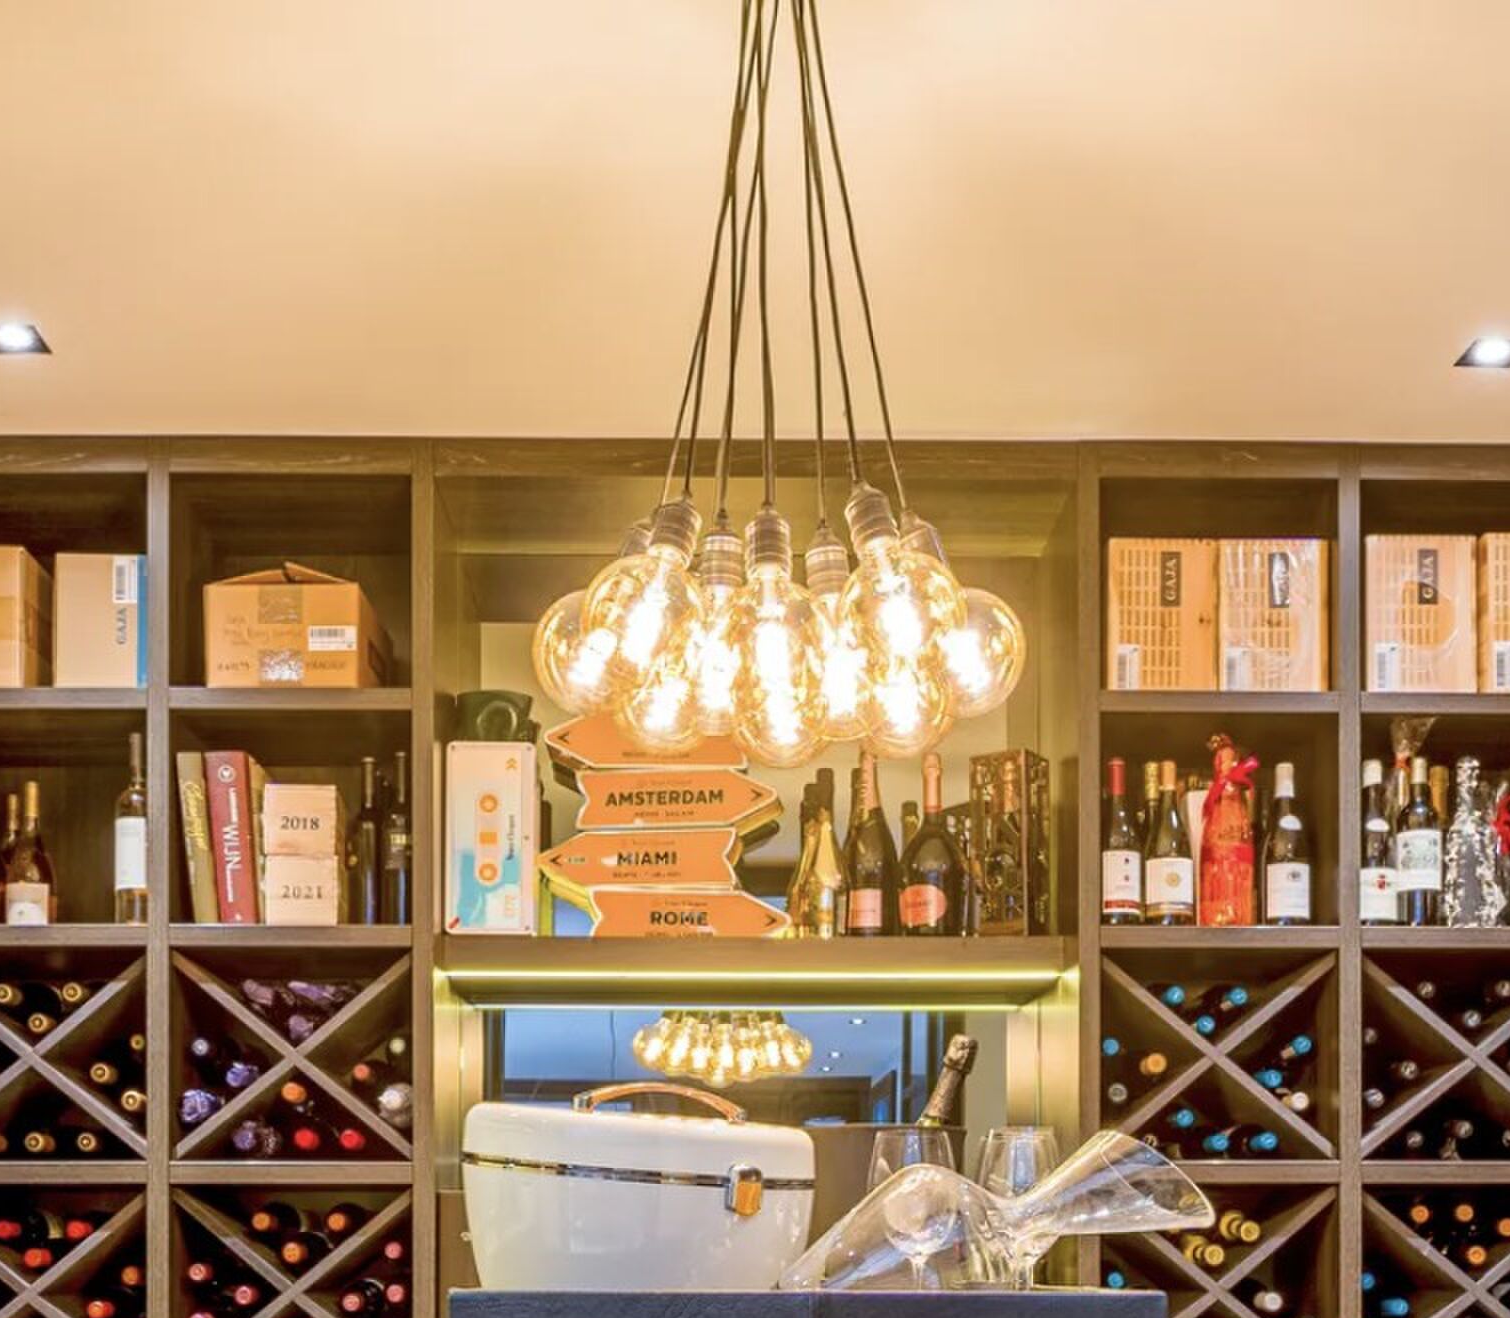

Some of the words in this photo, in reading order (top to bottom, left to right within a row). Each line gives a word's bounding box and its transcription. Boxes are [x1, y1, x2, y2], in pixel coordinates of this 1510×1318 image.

[1164, 558, 1177, 602] GAJA
[1421, 556, 1434, 599] GAJA
[116, 606, 128, 646] GAJA
[604, 788, 724, 807] AMSTERDAM
[280, 815, 320, 830] 2018
[617, 850, 677, 865] MIAMI
[281, 884, 323, 900] 2021
[649, 911, 709, 926] ROME
